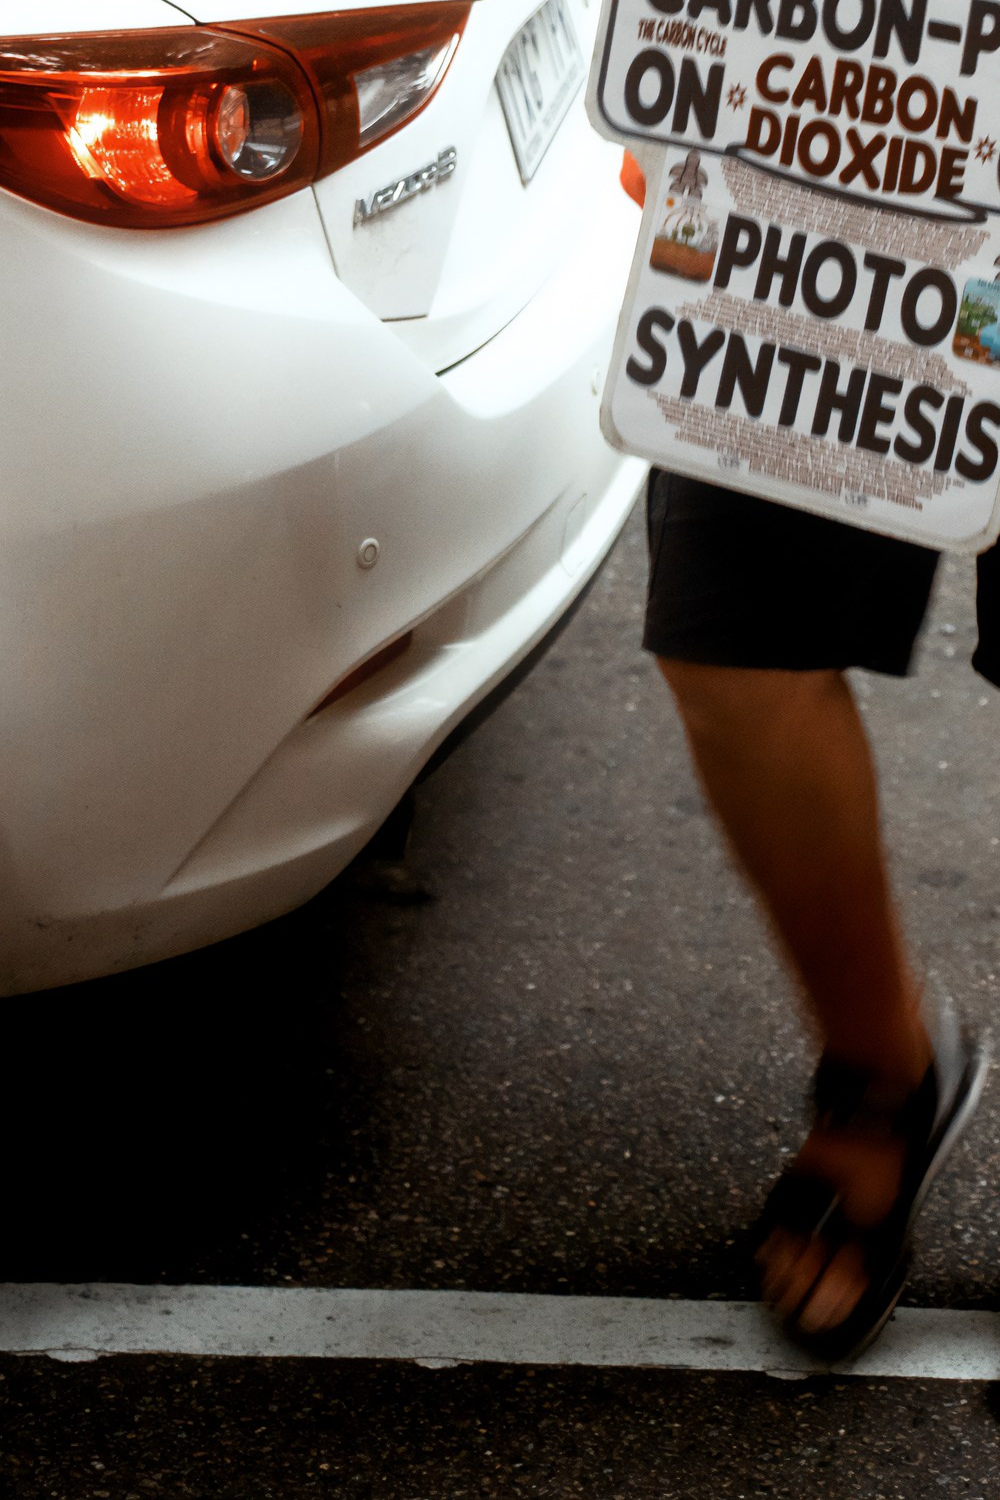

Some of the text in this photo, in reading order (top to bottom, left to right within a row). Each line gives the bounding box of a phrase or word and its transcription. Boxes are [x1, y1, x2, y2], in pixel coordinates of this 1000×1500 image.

[624, 46, 725, 140] ON
[755, 53, 978, 144] CARBON
[744, 106, 970, 199] DIOXIDE
[713, 212, 958, 349] PHOTO
